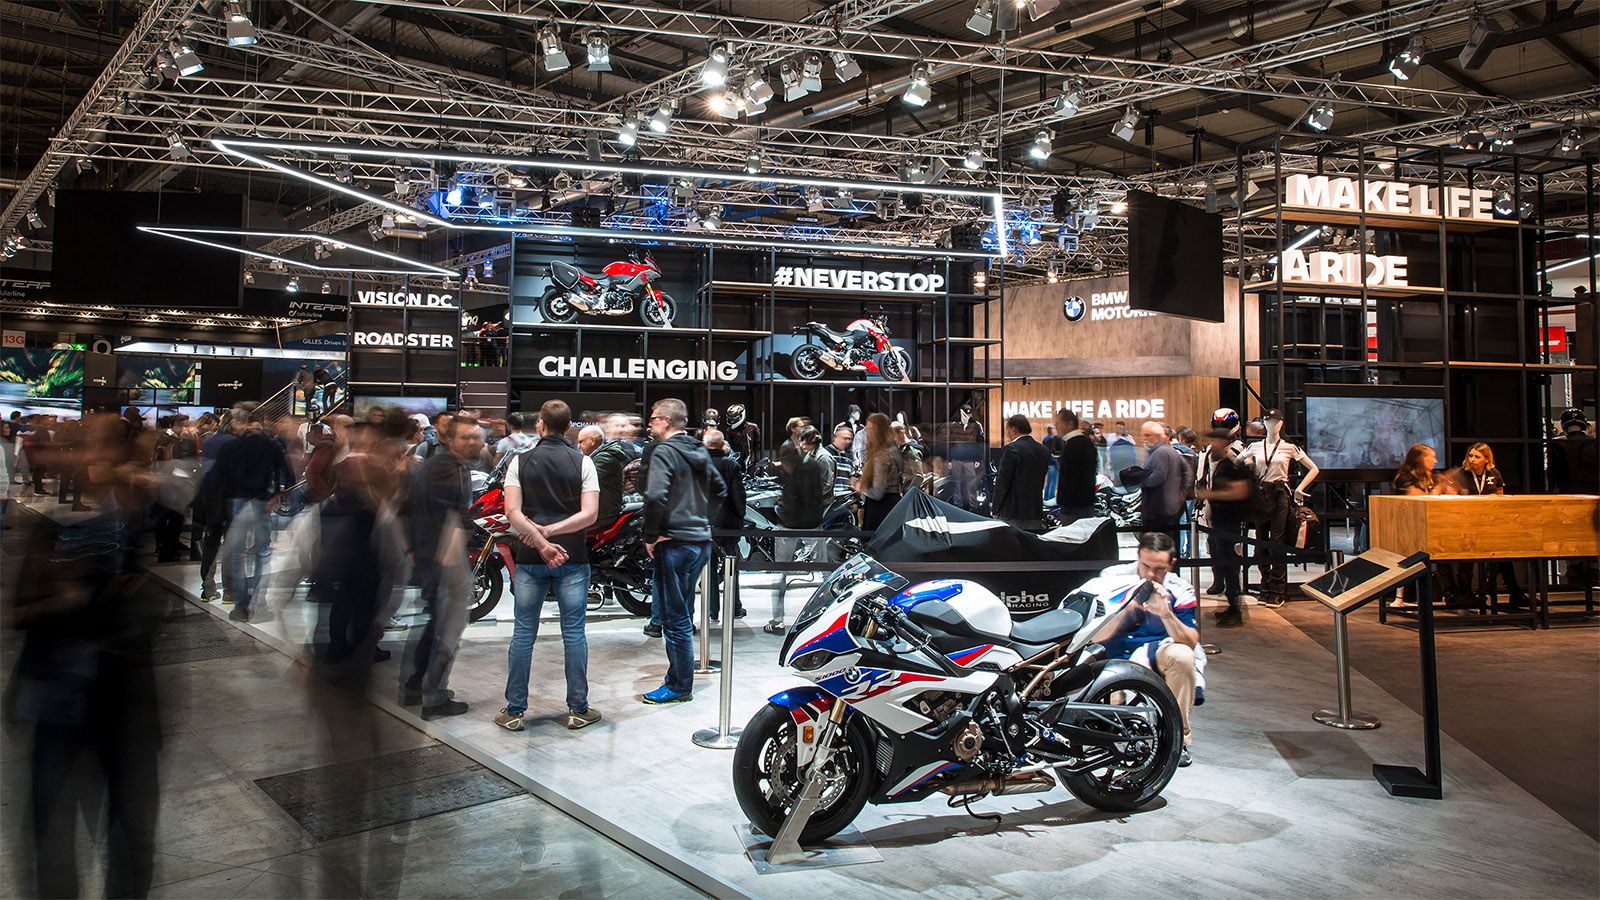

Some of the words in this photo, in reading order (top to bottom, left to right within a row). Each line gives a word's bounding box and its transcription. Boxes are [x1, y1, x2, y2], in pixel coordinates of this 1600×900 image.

[1287, 174, 1409, 213] MAKE
[1282, 250, 1311, 282] A
[1310, 252, 1408, 286] RIDE
[774, 267, 944, 292] #NEVERSTOP
[357, 291, 421, 306] VISION
[427, 293, 453, 307] DC
[1091, 291, 1128, 306] BMW
[4, 335, 24, 344] 13G
[354, 332, 453, 347] ROADSTER
[538, 356, 738, 381] CHALLENGING
[1003, 401, 1052, 418] MAKE
[1098, 399, 1112, 418] A
[1116, 399, 1164, 418] RIDE
[999, 590, 1049, 607] lpha
